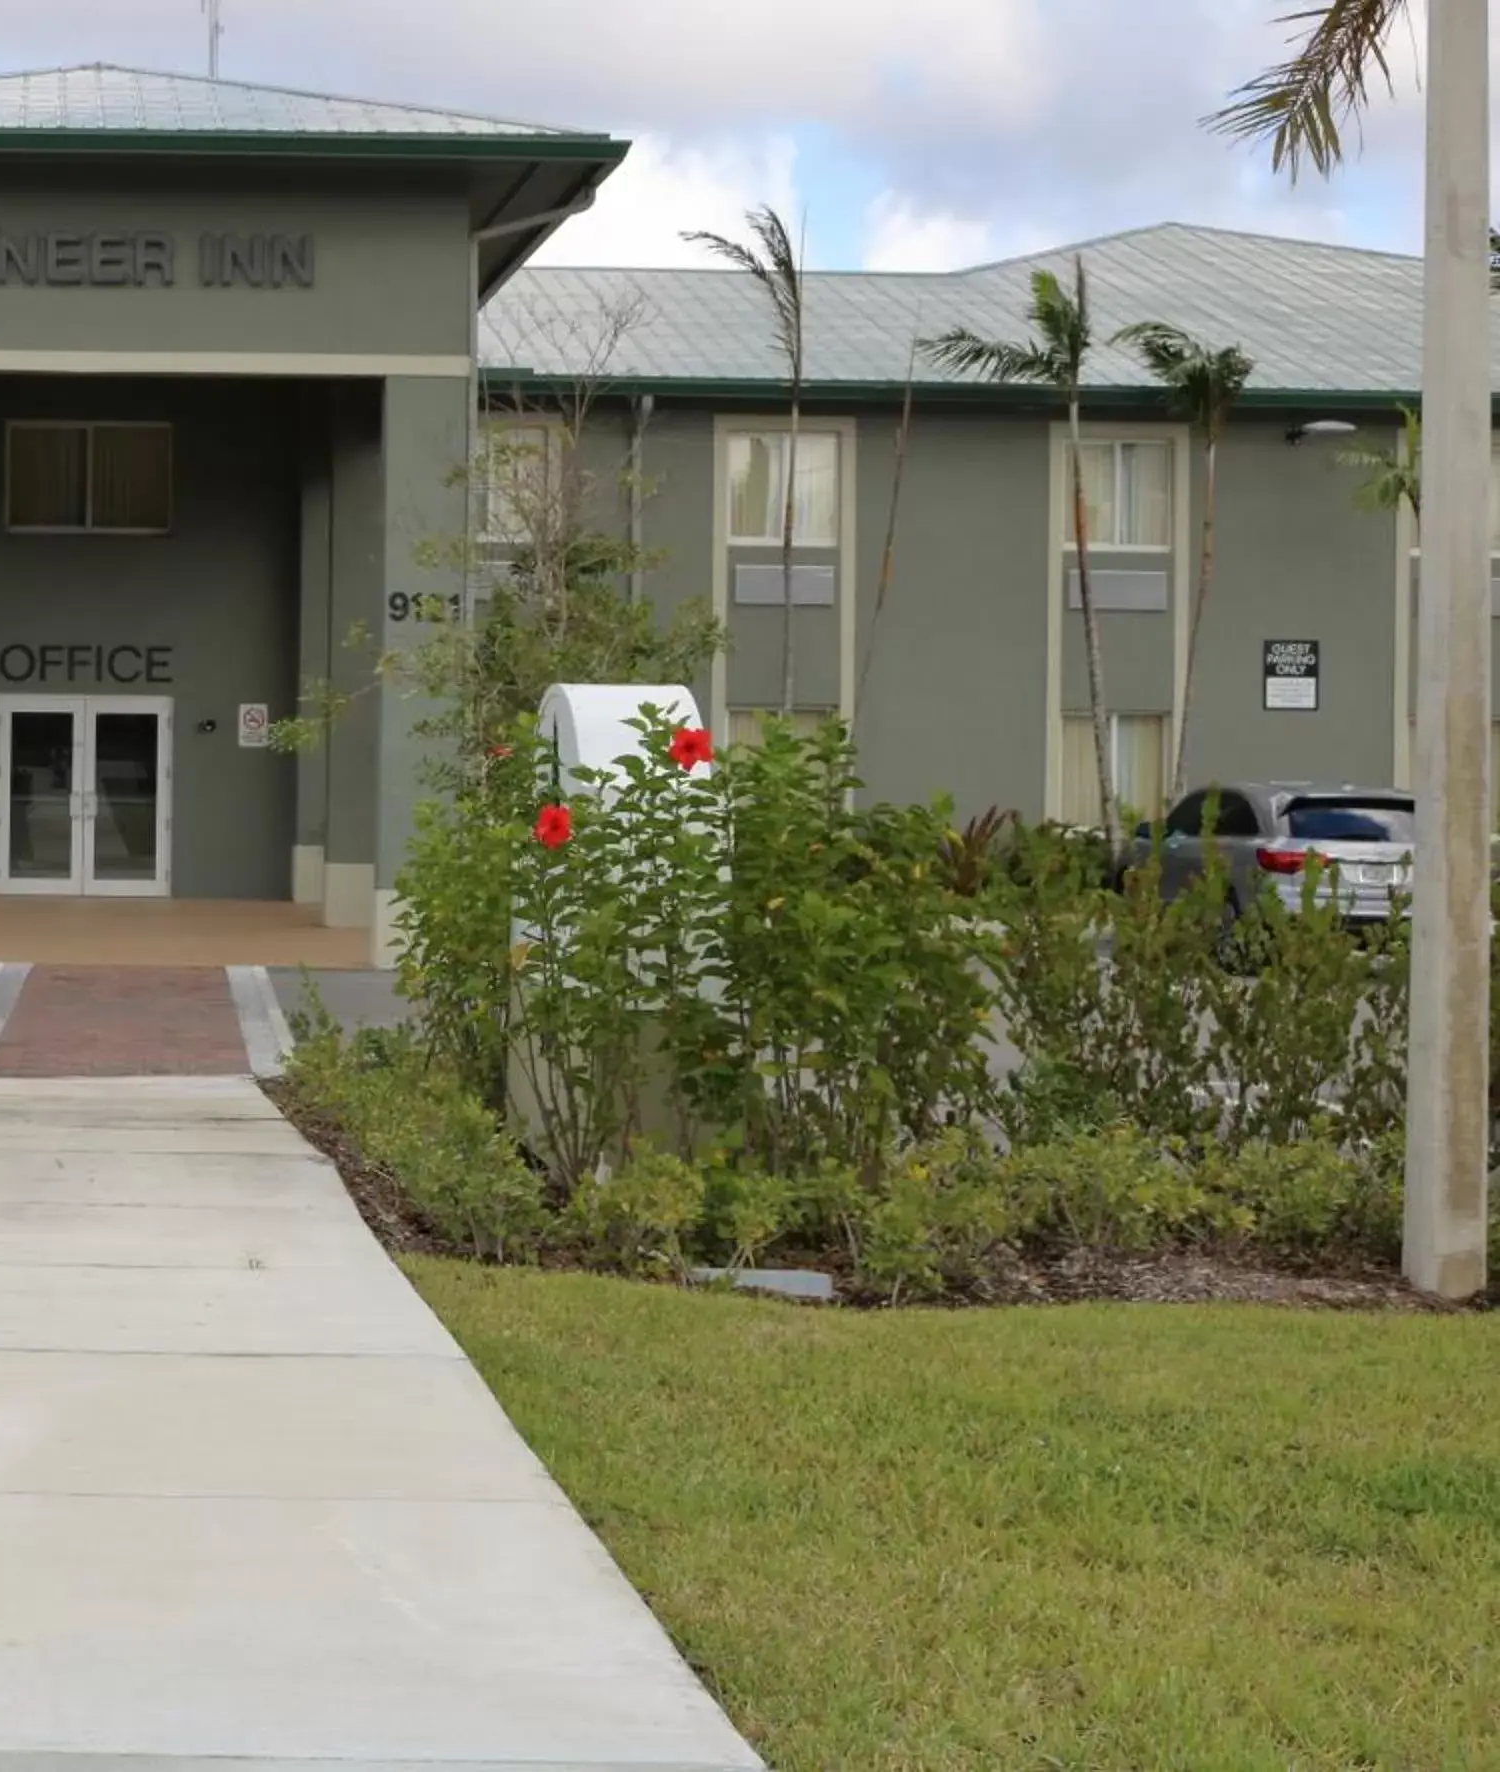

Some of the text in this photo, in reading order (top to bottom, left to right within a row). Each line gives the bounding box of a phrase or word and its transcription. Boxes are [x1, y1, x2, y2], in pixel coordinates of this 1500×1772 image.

[198, 230, 316, 289] INN
[1271, 644, 1311, 655] GUEST
[0, 644, 173, 682] OFFICE
[1266, 654, 1317, 665] PARKING
[1275, 664, 1306, 674] ONLY
